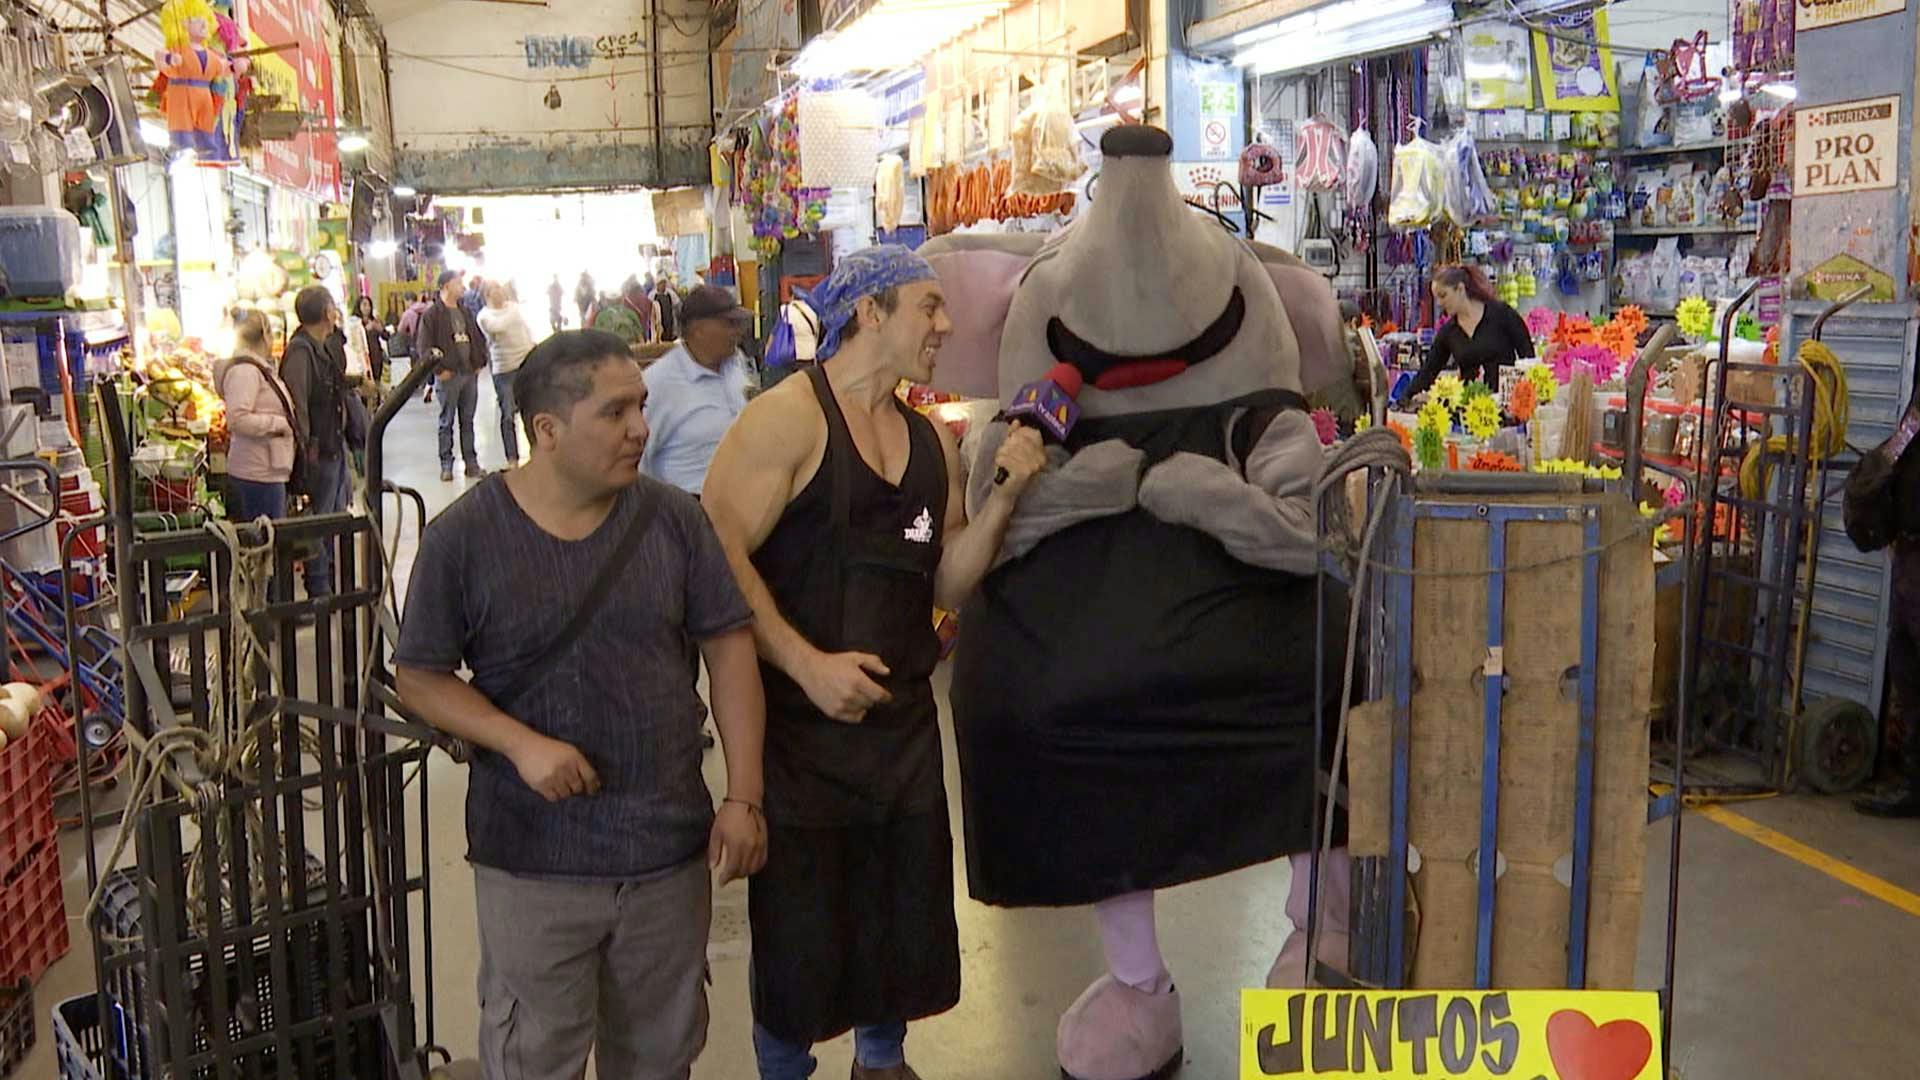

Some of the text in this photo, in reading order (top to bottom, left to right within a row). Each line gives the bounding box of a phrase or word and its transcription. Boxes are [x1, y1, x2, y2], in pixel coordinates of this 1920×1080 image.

[1829, 107, 1880, 124] PURINA
[1815, 134, 1874, 160] PRO
[1805, 157, 1882, 188] PLAN
[1824, 272, 1861, 282] PURINA
[1256, 991, 1520, 1075] JUNTOS
